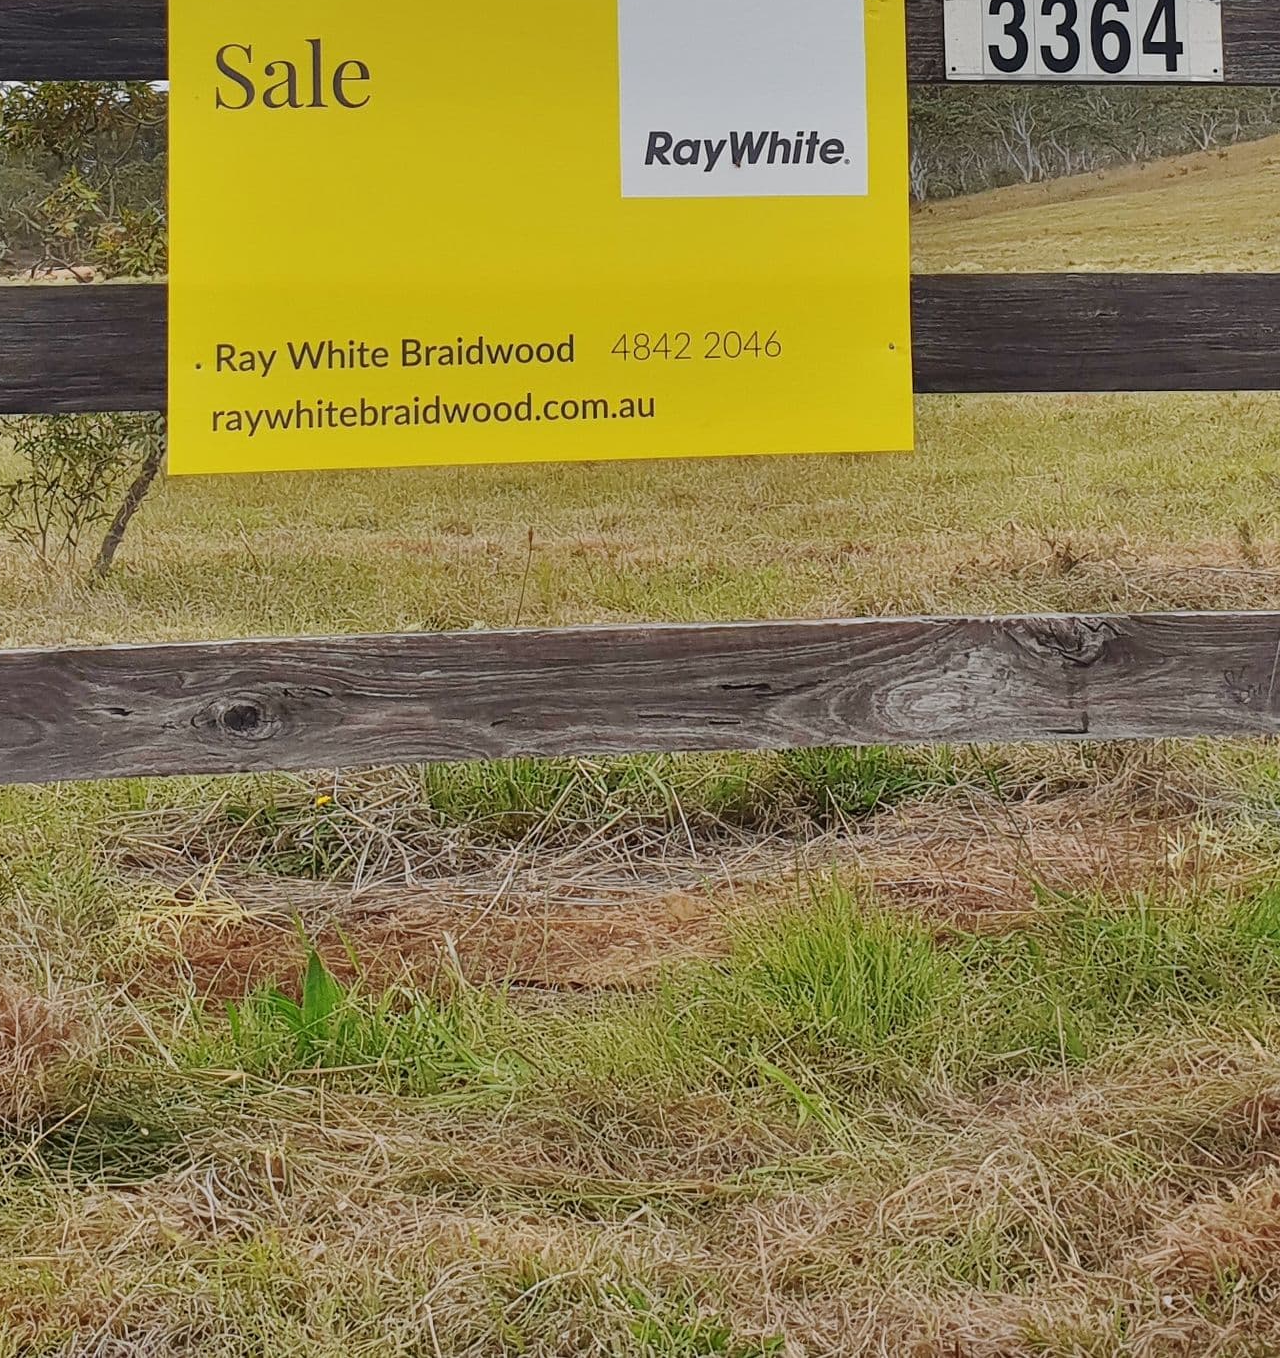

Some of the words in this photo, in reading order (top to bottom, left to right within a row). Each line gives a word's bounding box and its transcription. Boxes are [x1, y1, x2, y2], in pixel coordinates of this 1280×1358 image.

[215, 38, 372, 111] Sale
[215, 342, 278, 377] Ray
[287, 339, 390, 370] White
[401, 333, 575, 368] Braidwood
[611, 331, 692, 363] 4842
[704, 329, 783, 360] 2046
[211, 393, 656, 436] raywhitebraidwood.com.au
